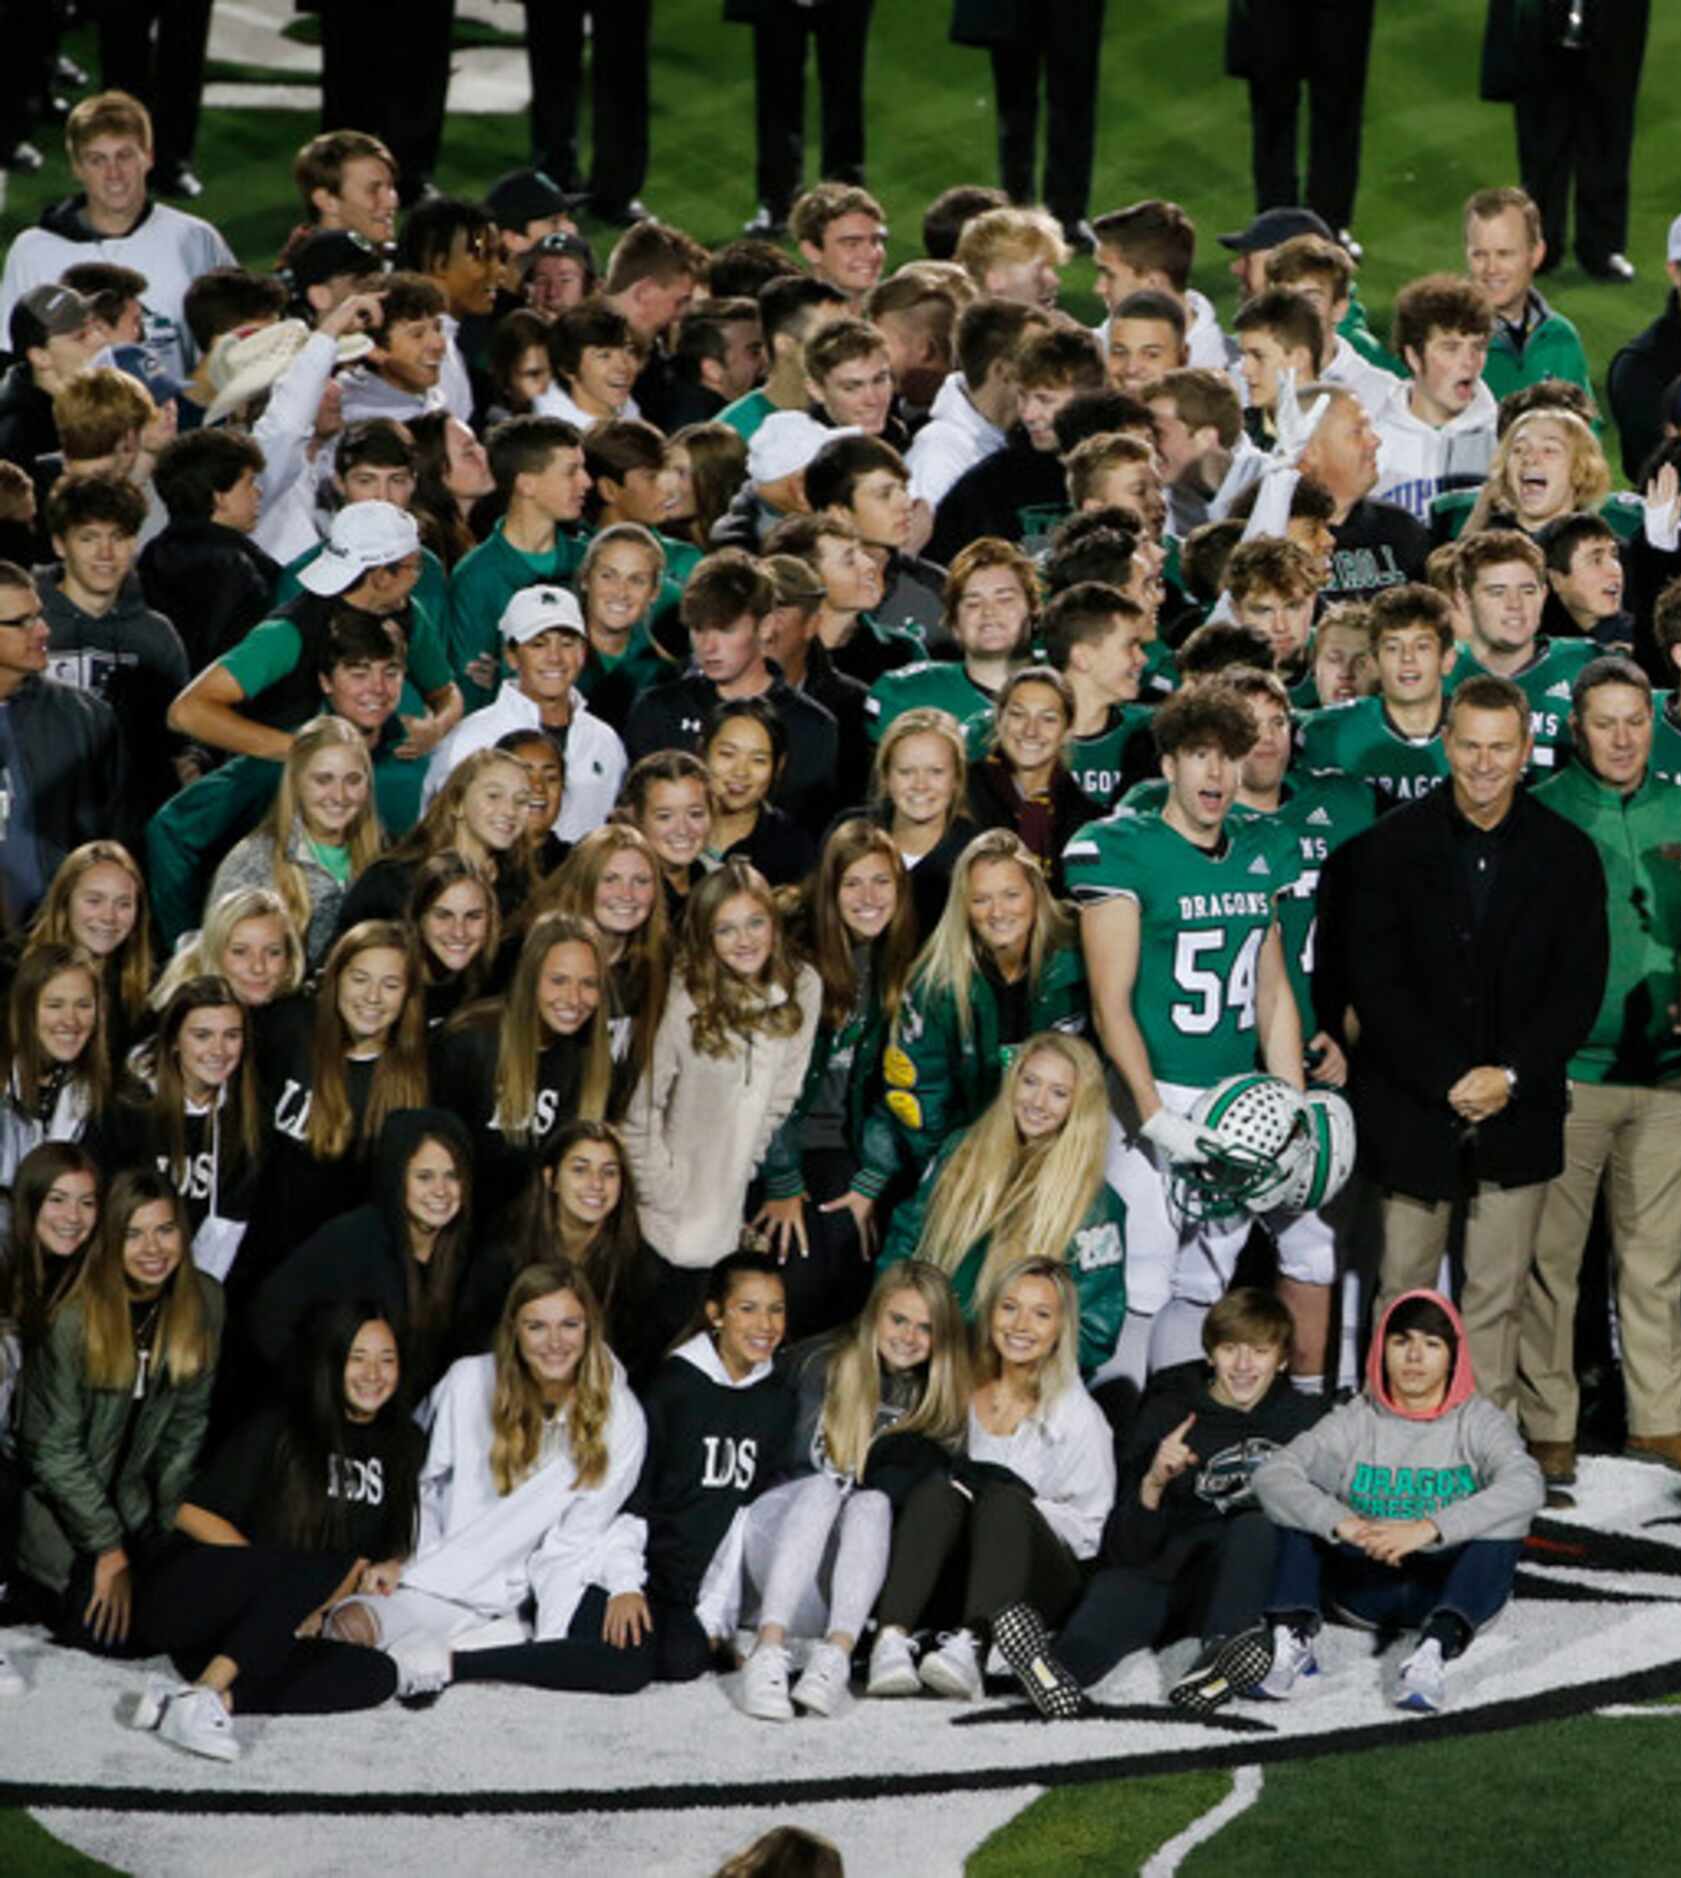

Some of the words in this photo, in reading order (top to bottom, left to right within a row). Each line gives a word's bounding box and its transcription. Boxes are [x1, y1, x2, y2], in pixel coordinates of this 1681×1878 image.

[1178, 892, 1269, 921] DRAGONS
[1171, 928, 1265, 1034] 54
[702, 1436, 757, 1491] LDS
[1351, 1461, 1478, 1498] DRAGON
